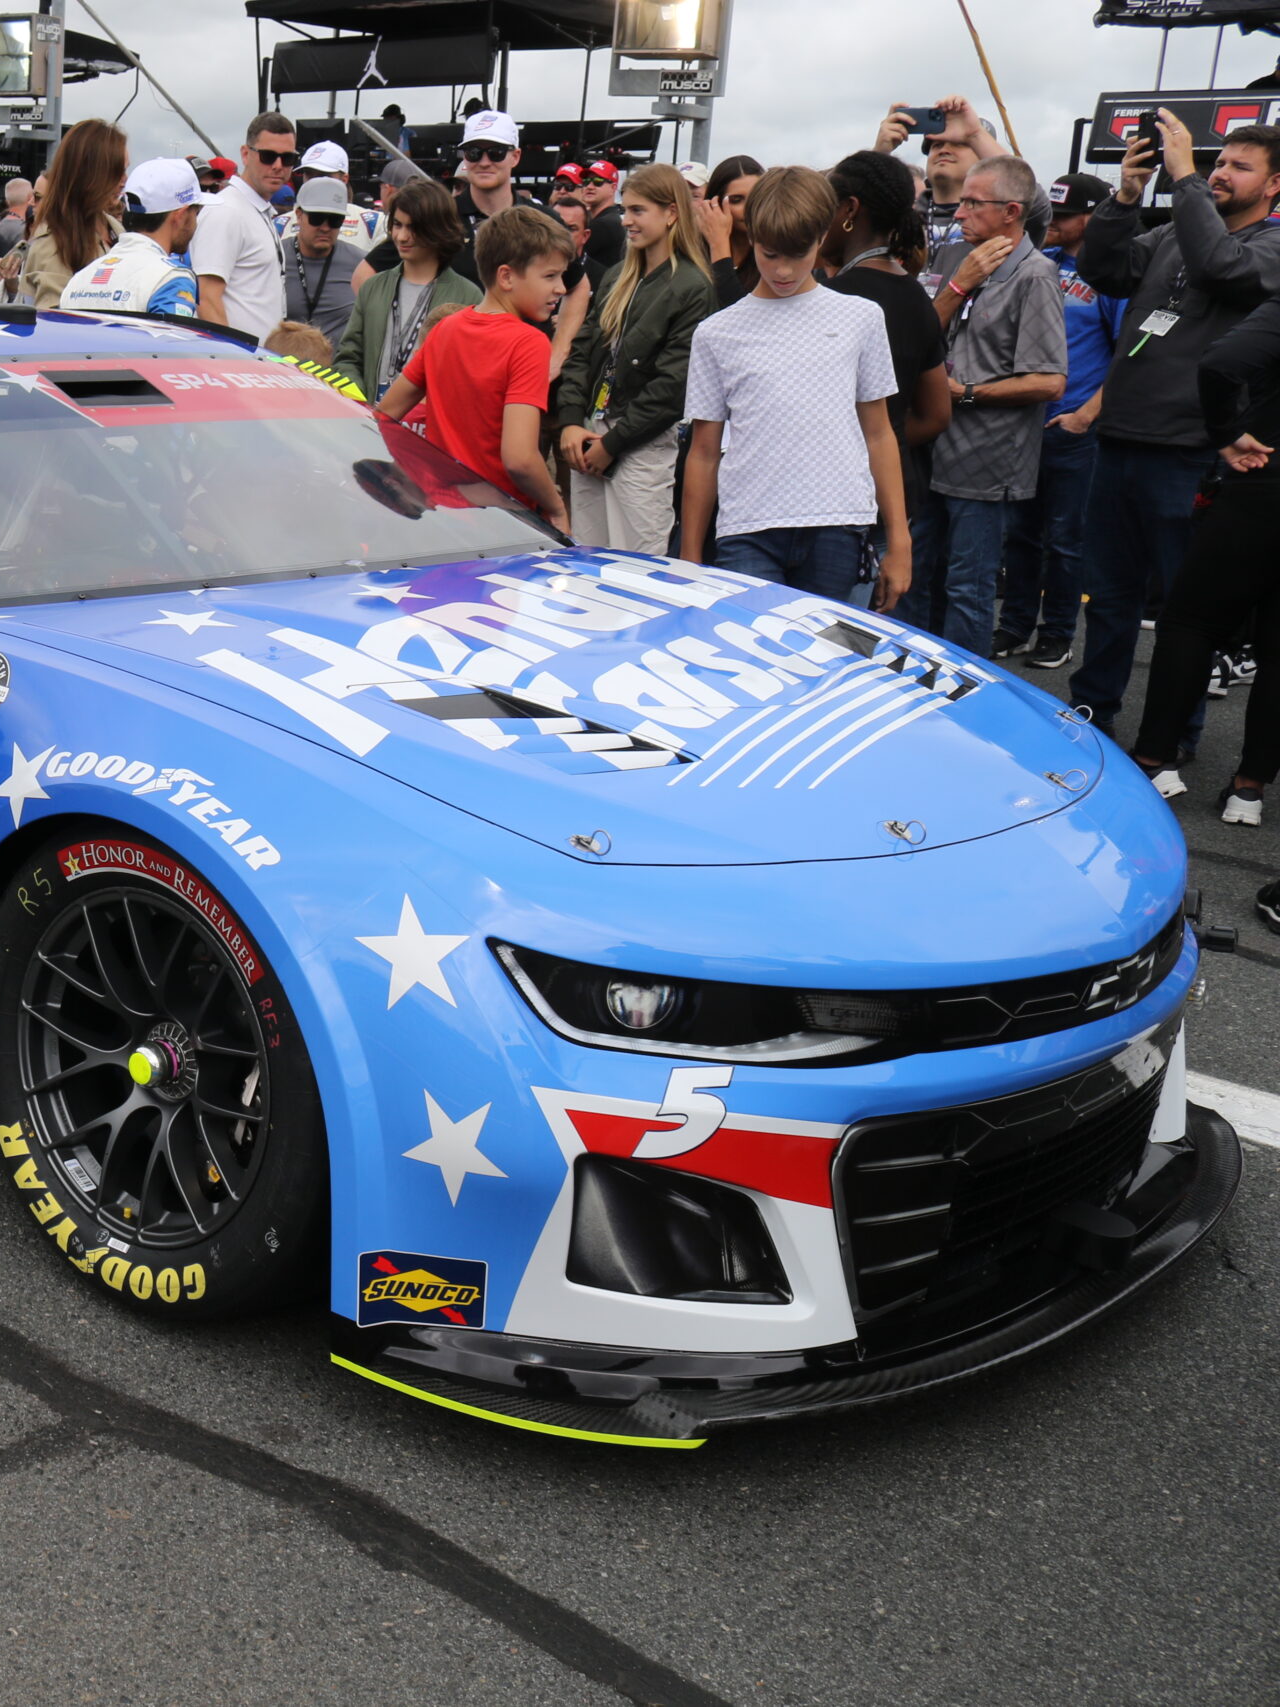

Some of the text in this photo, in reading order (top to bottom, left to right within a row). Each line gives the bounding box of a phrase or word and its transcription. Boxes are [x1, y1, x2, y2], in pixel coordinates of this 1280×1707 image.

[160, 373, 229, 390] SP4
[46, 751, 282, 871] GOODYEAR
[81, 843, 256, 979] HONOR AND REMEMBER
[631, 1065, 735, 1159] 5
[370, 1278, 475, 1305] SUNOCO
